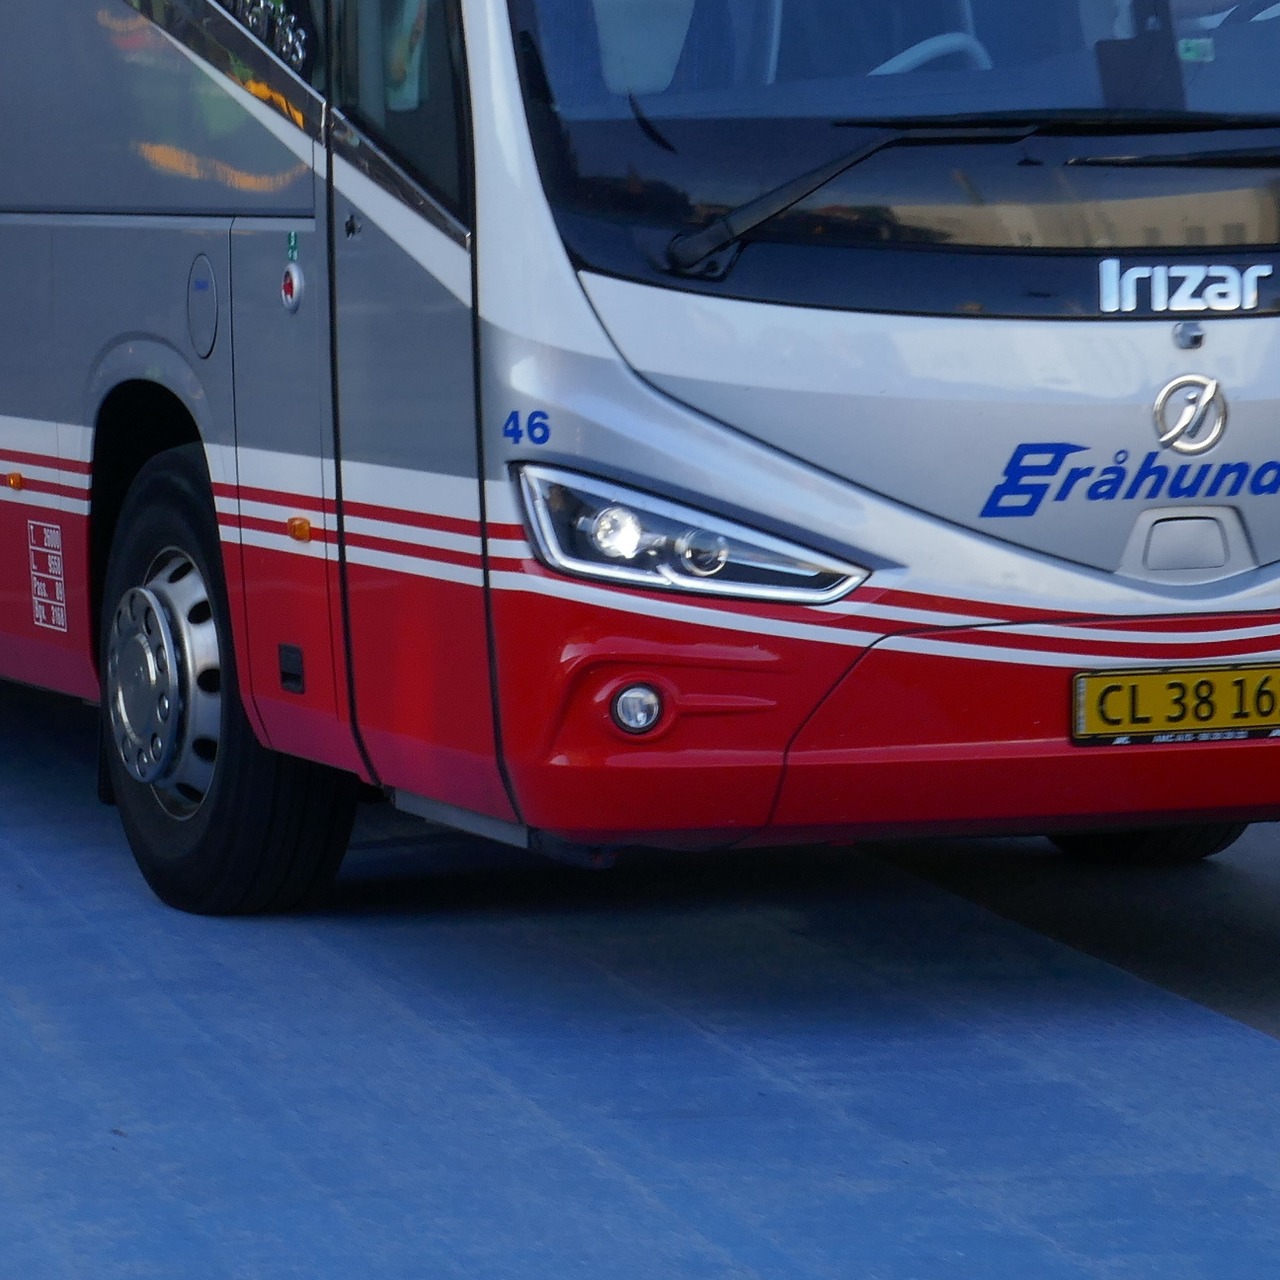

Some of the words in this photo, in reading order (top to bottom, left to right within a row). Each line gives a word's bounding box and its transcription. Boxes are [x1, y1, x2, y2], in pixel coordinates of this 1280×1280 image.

[1098, 258, 1273, 313] Irizar
[503, 410, 550, 445] 46
[1097, 683, 1152, 726] CL
[1166, 679, 1216, 723] 38
